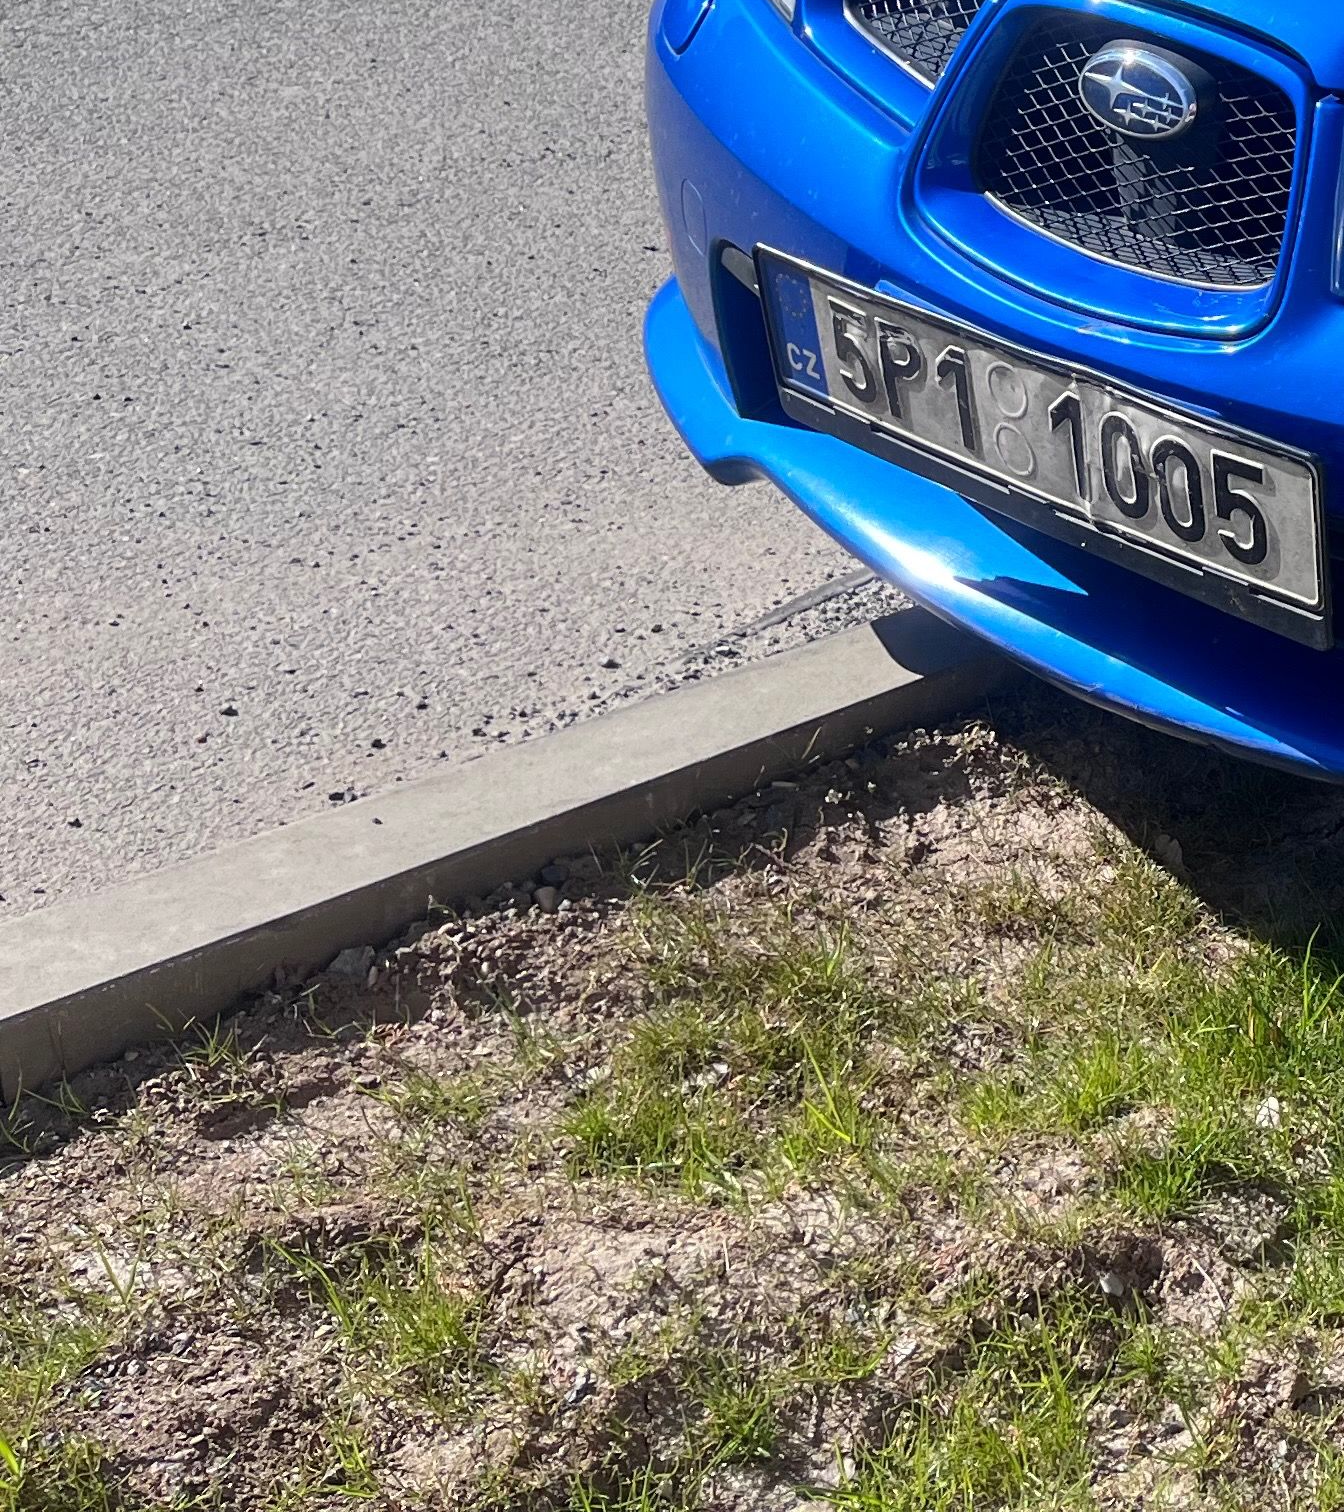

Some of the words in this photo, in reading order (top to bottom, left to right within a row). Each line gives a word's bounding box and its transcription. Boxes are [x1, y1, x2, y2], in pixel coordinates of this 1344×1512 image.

[787, 342, 821, 380] CZ
[826, 295, 979, 452] 5P1
[1047, 389, 1268, 566] 1005
